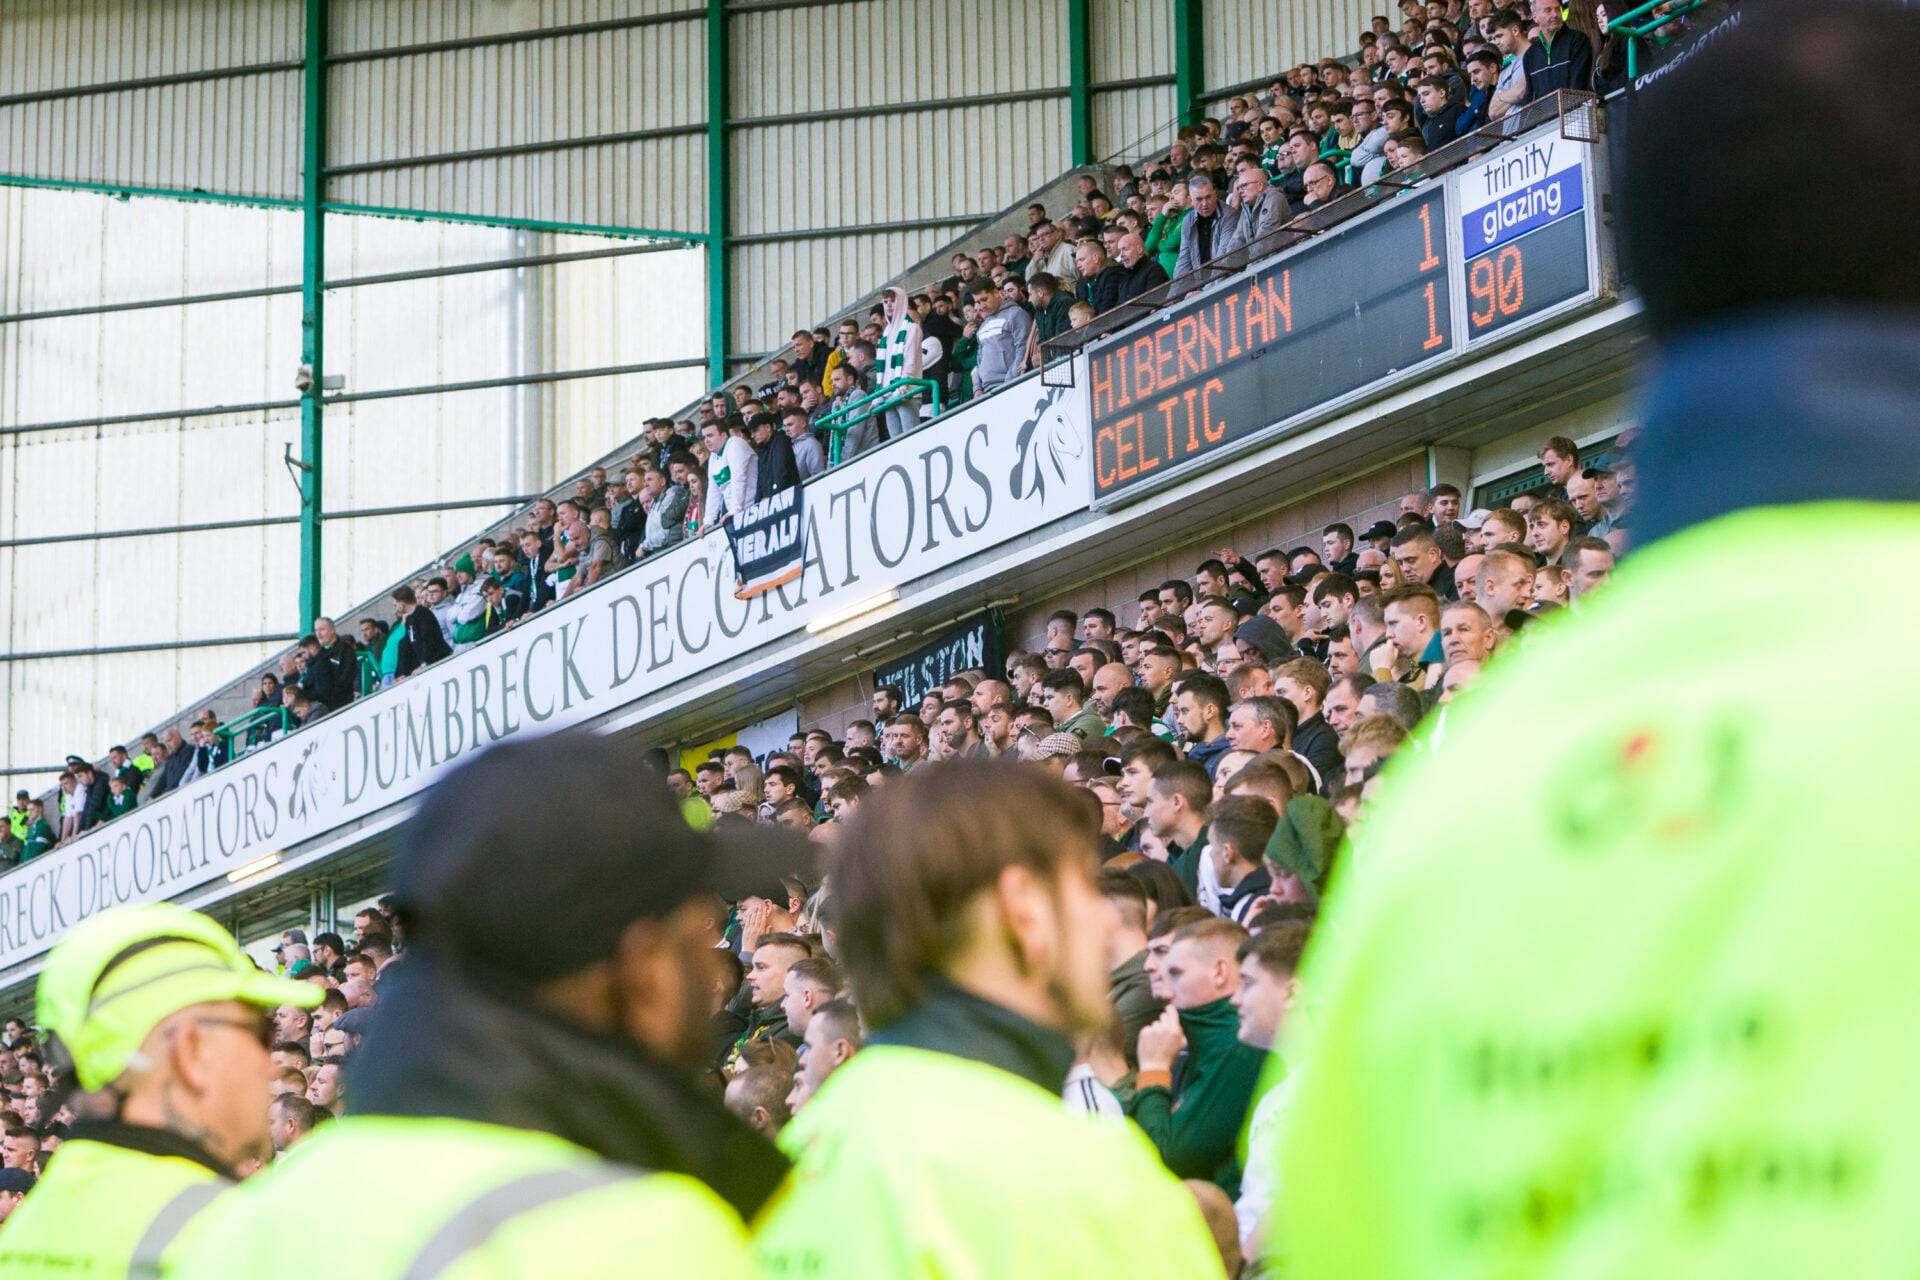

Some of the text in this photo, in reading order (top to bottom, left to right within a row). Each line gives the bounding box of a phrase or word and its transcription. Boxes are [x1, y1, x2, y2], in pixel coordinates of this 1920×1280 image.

[1483, 181, 1561, 244] glazing
[1484, 142, 1554, 195] trinity
[1092, 203, 1439, 419] HIBERNIAN 1
[1470, 244, 1524, 328] 90
[1095, 281, 1443, 489] CELTIC 1
[342, 613, 595, 807] DUMBRECK
[77, 761, 278, 922] DECORATORS
